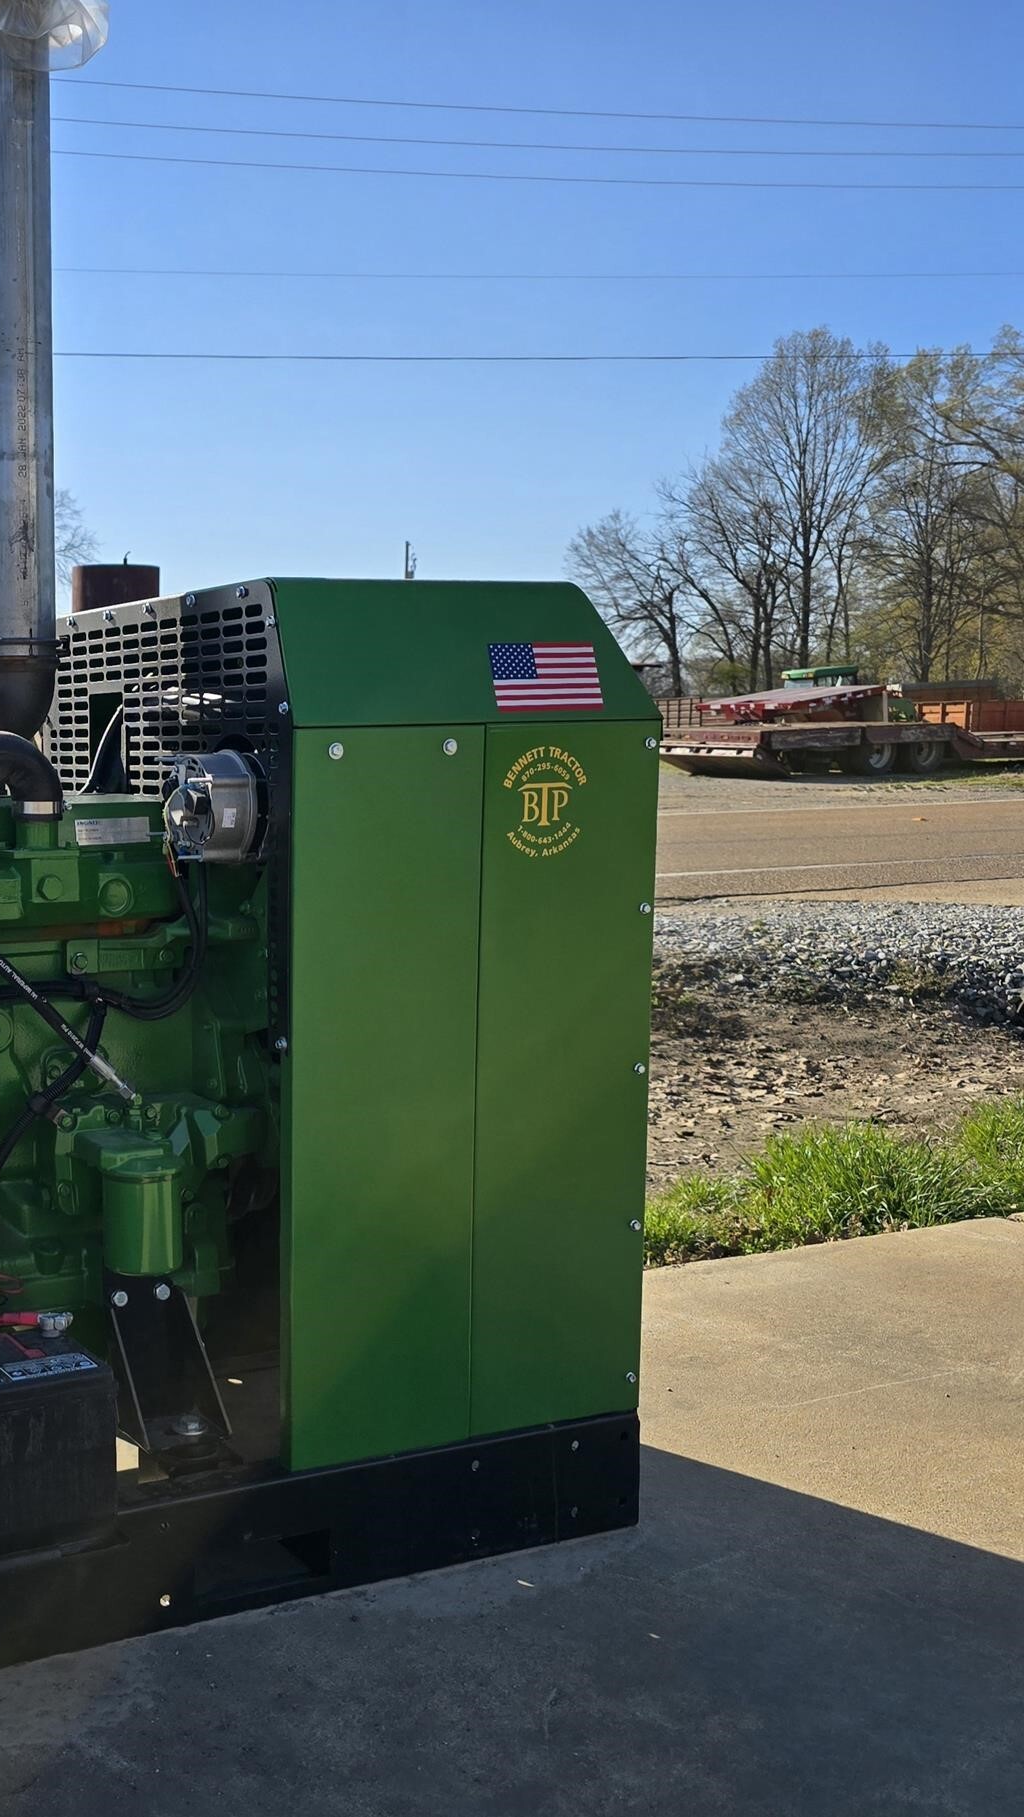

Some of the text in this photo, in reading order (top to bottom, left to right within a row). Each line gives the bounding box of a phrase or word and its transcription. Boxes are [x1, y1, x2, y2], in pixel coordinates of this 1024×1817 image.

[17, 404, 27, 432] 2022
[17, 464, 27, 478] 28
[503, 747, 587, 789] BENNETT TRACTOR
[517, 782, 573, 826] BTP
[506, 827, 581, 858] Aubrey, Arkansas
